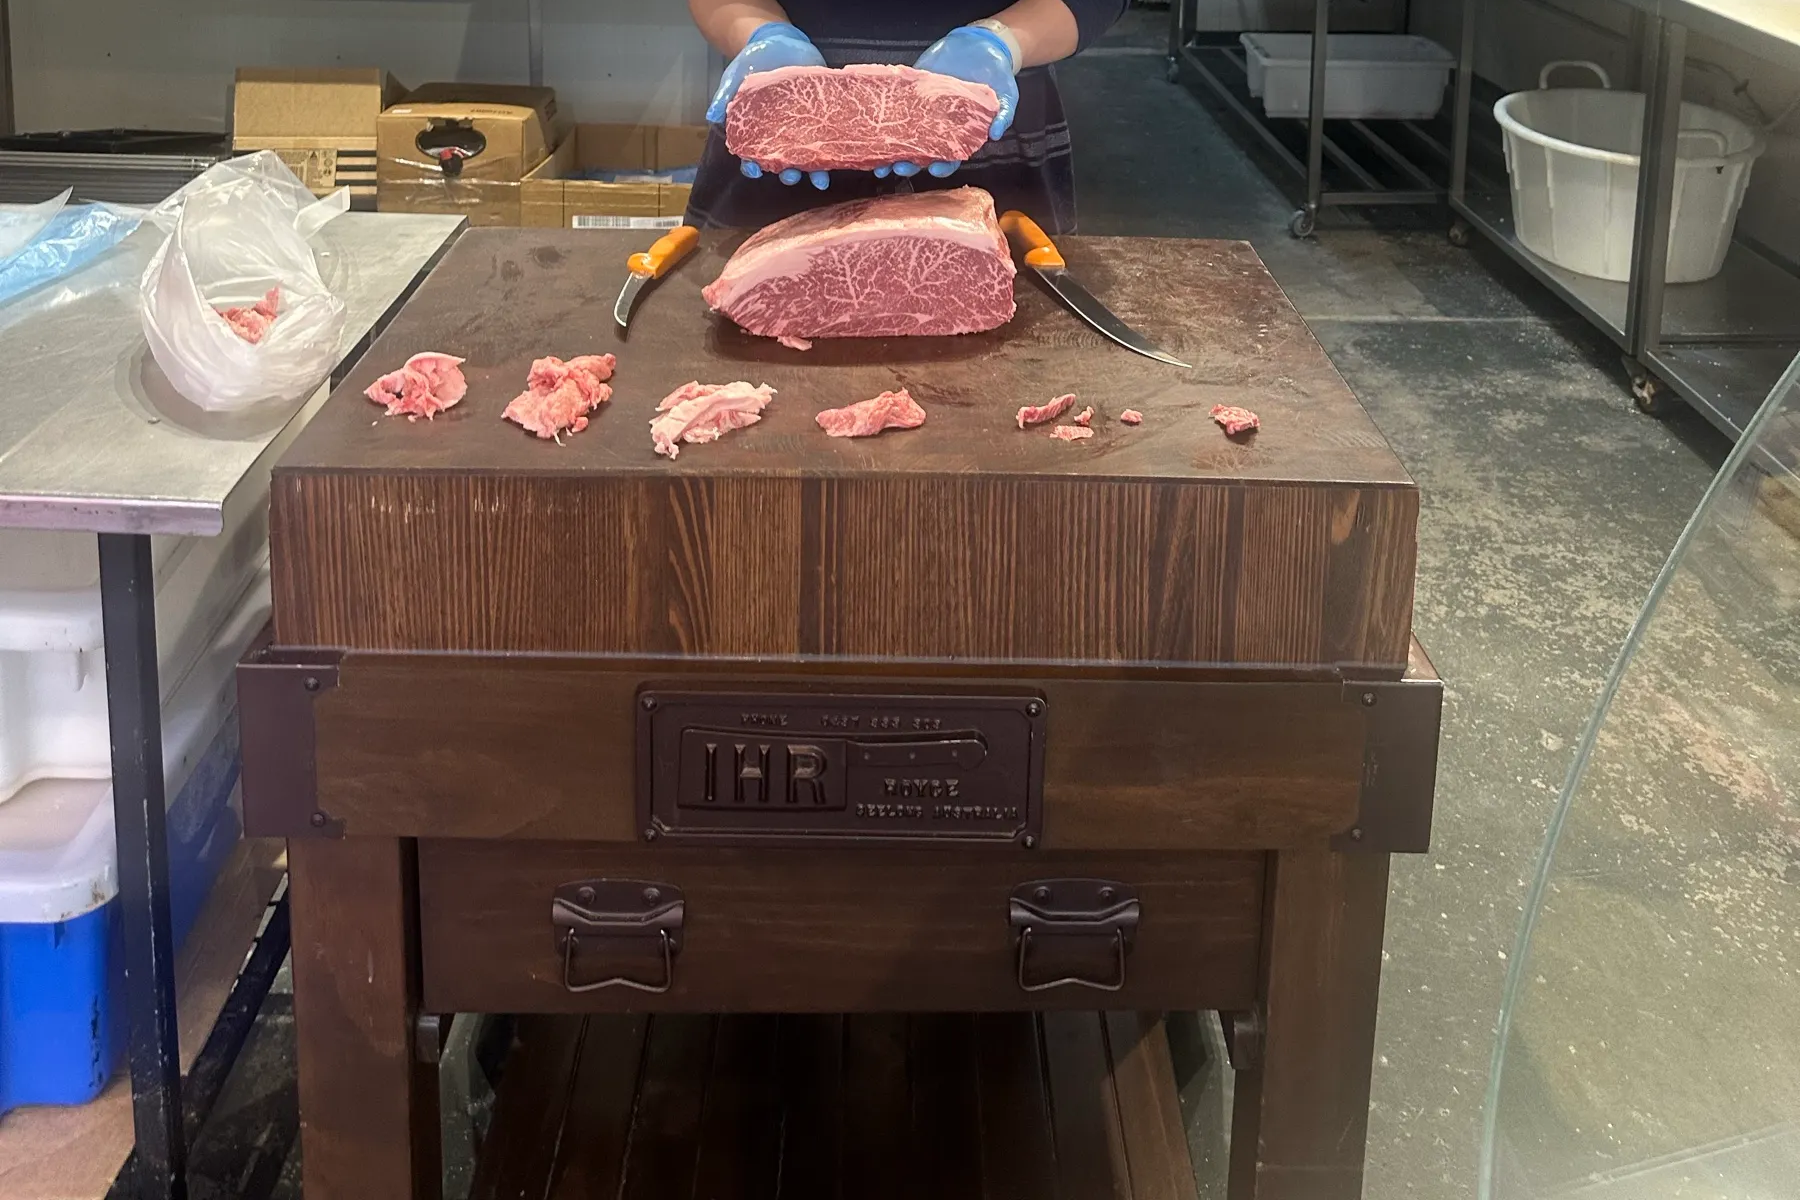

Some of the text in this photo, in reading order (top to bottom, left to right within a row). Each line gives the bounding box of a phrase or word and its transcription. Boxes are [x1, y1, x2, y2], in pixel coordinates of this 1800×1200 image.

[705, 743, 827, 804] IHR
[856, 802, 1018, 819] GEELONG AUSTRALIA
